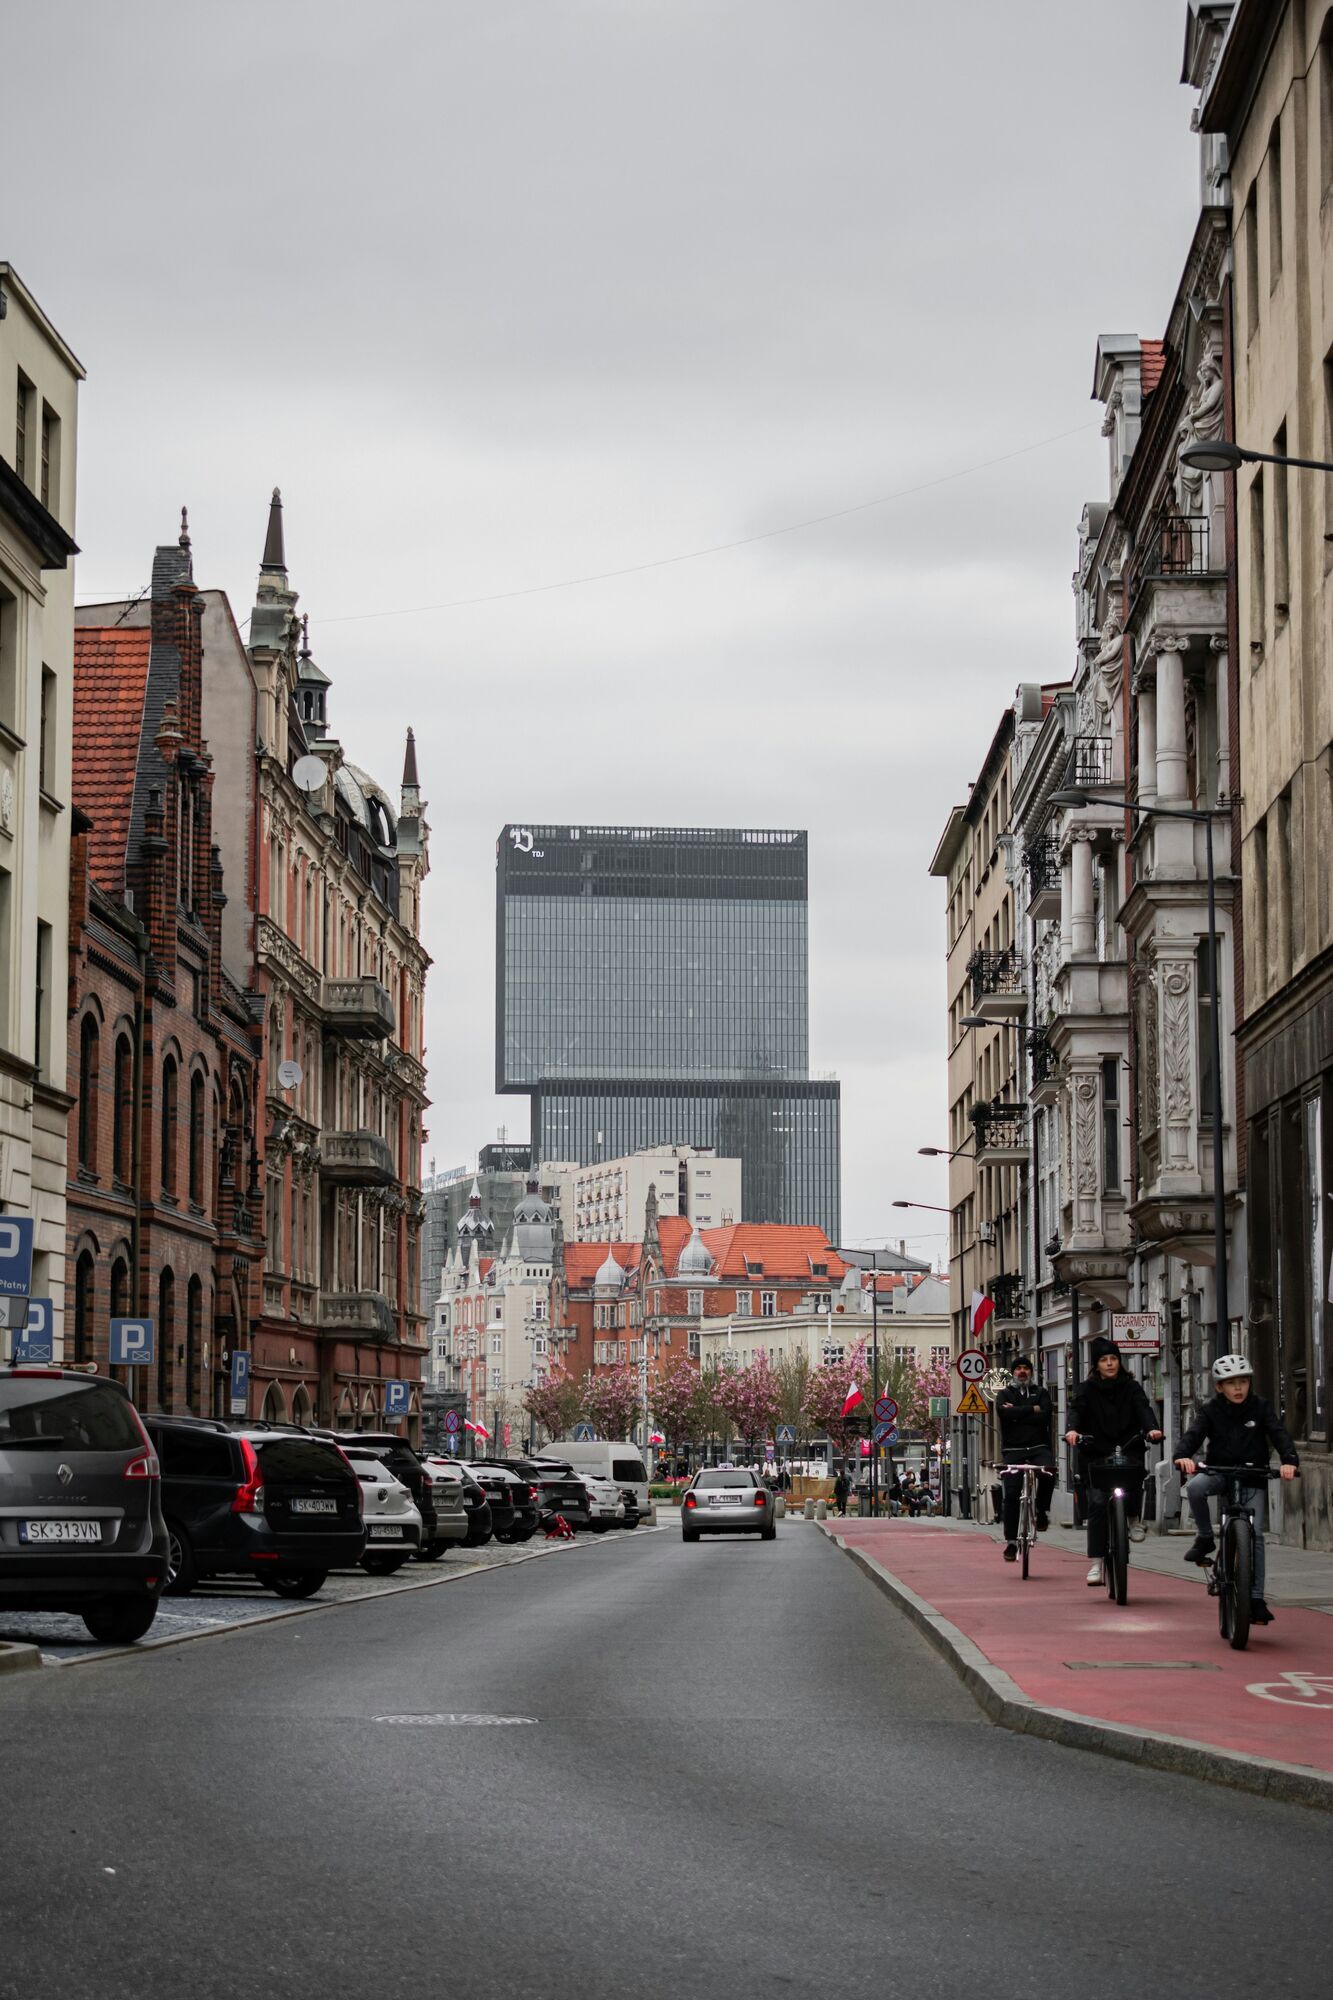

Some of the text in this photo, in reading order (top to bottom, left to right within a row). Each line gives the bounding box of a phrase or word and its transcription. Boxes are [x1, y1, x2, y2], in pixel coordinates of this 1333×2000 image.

[22, 1303, 45, 1342] P
[121, 1324, 145, 1358] P
[235, 1356, 246, 1384] P
[963, 1359, 985, 1373] 20
[390, 1384, 404, 1405] P
[298, 1500, 309, 1511] SK
[30, 1523, 98, 1538] SK 313VN
